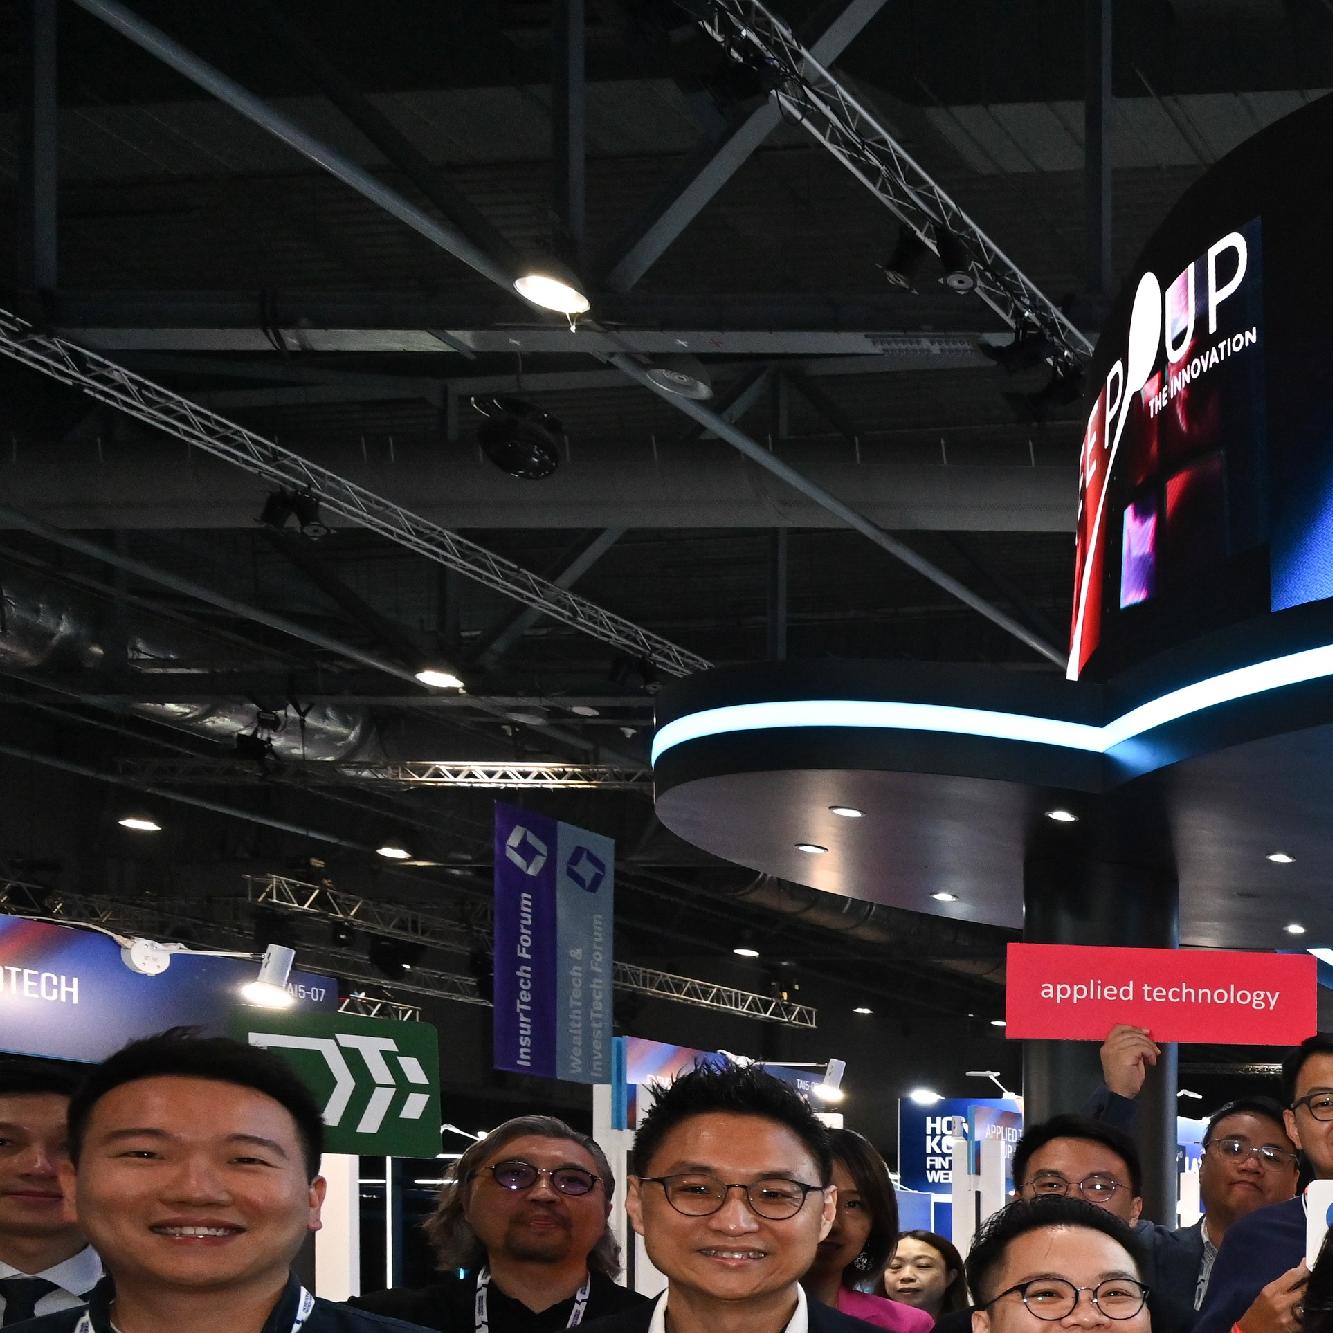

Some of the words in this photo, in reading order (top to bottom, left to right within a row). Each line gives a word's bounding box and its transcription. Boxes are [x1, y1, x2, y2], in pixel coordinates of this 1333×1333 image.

[1165, 231, 1248, 365] UP
[1148, 389, 1168, 419] THE
[1169, 327, 1257, 400] INNOVATION
[516, 893, 532, 959] Forum
[570, 948, 583, 960] &
[592, 914, 604, 974] Forum
[0, 965, 79, 1004] TECH
[1040, 979, 1133, 1004] applied
[1142, 982, 1280, 1011] technology
[516, 967, 531, 1067] InsurTech
[568, 965, 583, 1074] WealthTech
[590, 977, 604, 1077] InvestTech
[926, 1116, 968, 1135] HO
[926, 1156, 953, 1169] FINT
